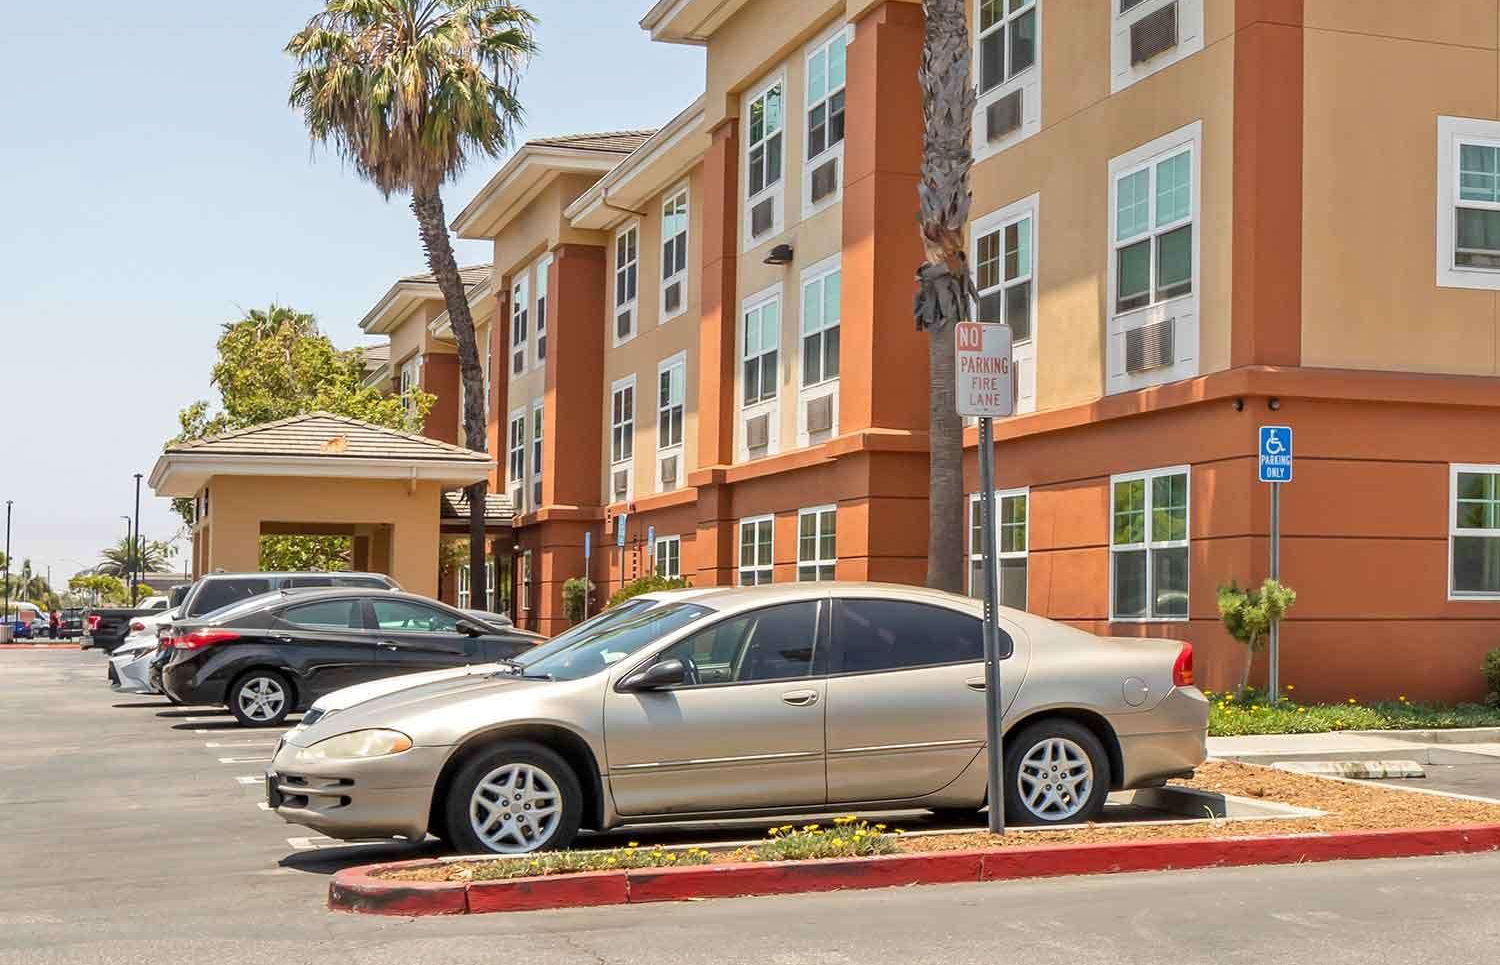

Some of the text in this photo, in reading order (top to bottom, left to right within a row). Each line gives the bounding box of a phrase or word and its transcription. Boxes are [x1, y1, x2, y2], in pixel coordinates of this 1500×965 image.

[960, 326, 979, 347] NO
[960, 356, 1009, 374] PARKING
[972, 377, 998, 390] FIRE
[970, 394, 1001, 406] LANE
[1261, 454, 1290, 465] PARKING
[1266, 467, 1285, 478] ONLY
